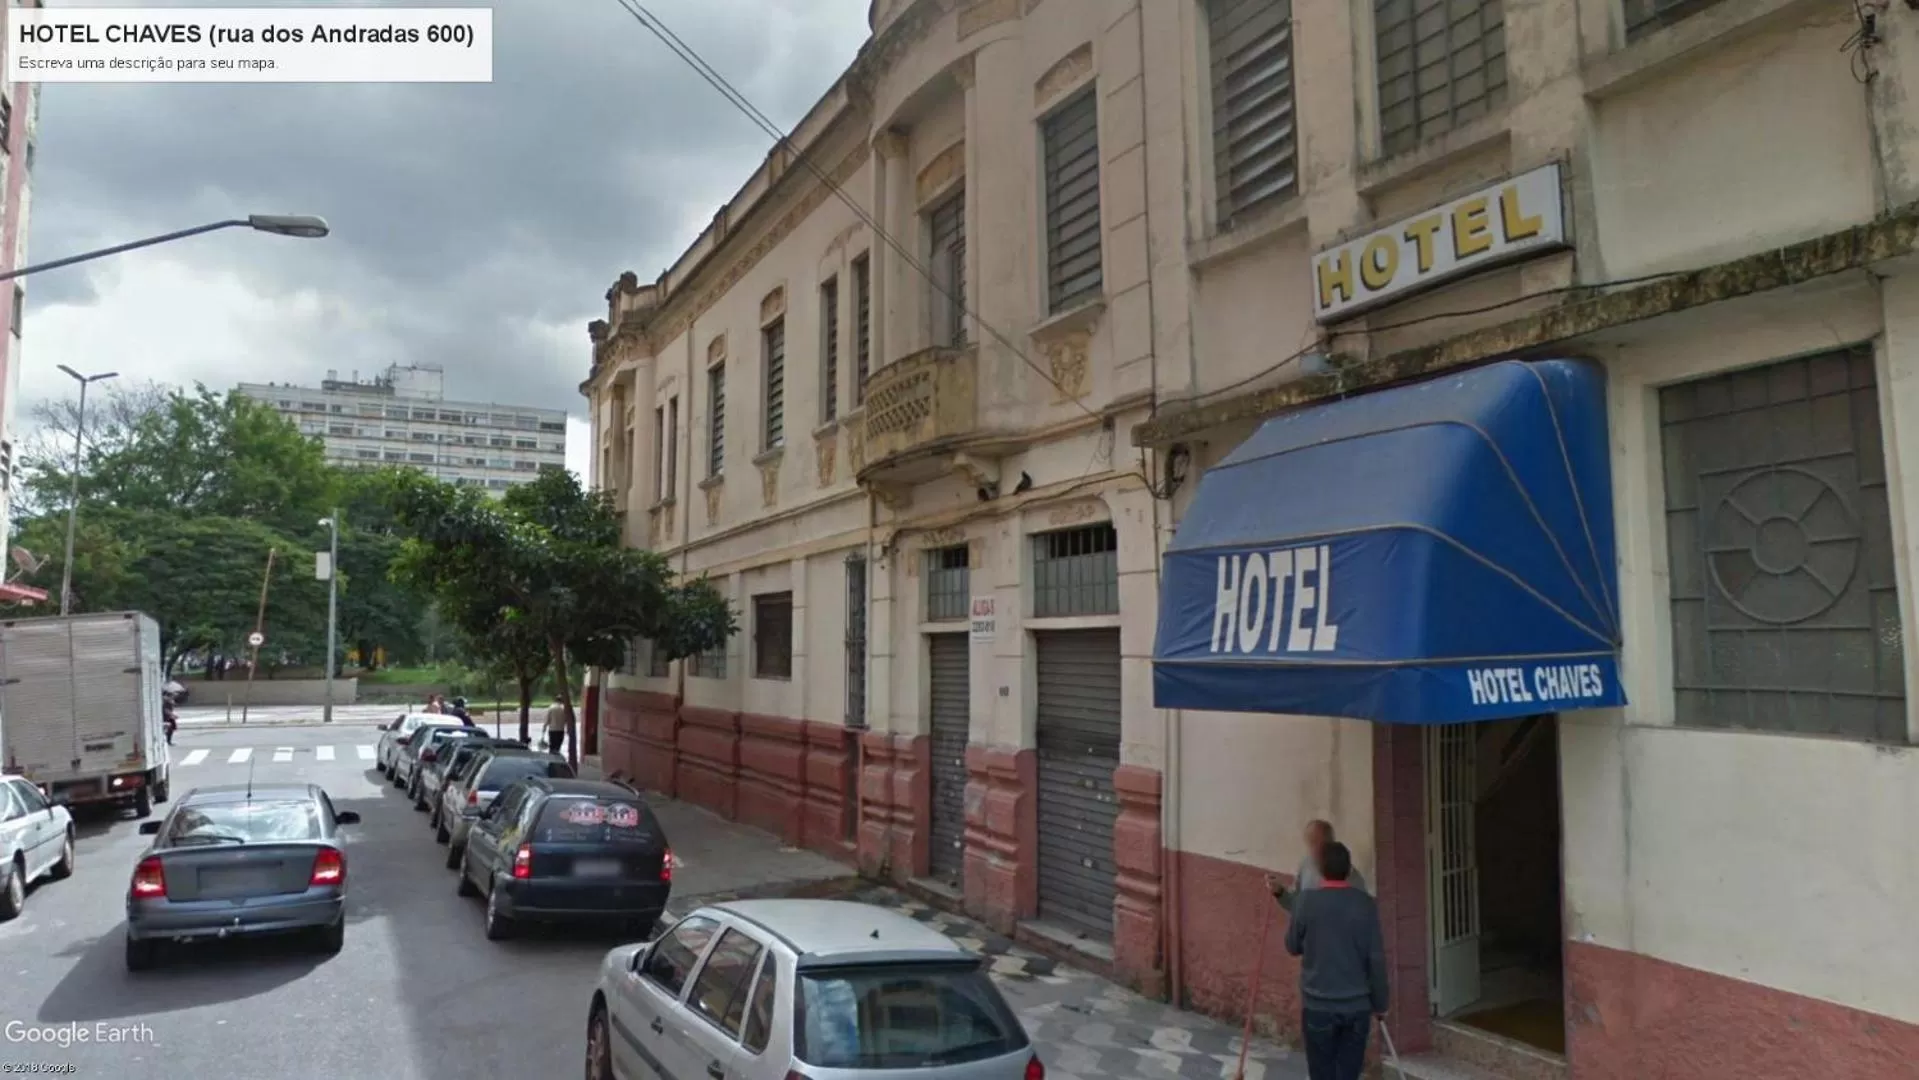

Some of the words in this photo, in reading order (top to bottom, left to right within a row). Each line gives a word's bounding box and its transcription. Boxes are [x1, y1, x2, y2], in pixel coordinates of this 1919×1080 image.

[1319, 184, 1543, 308] HOTEL
[1210, 545, 1338, 653] HOTEL
[1467, 667, 1534, 705] HOTEL
[1534, 663, 1603, 701] CHAVES
